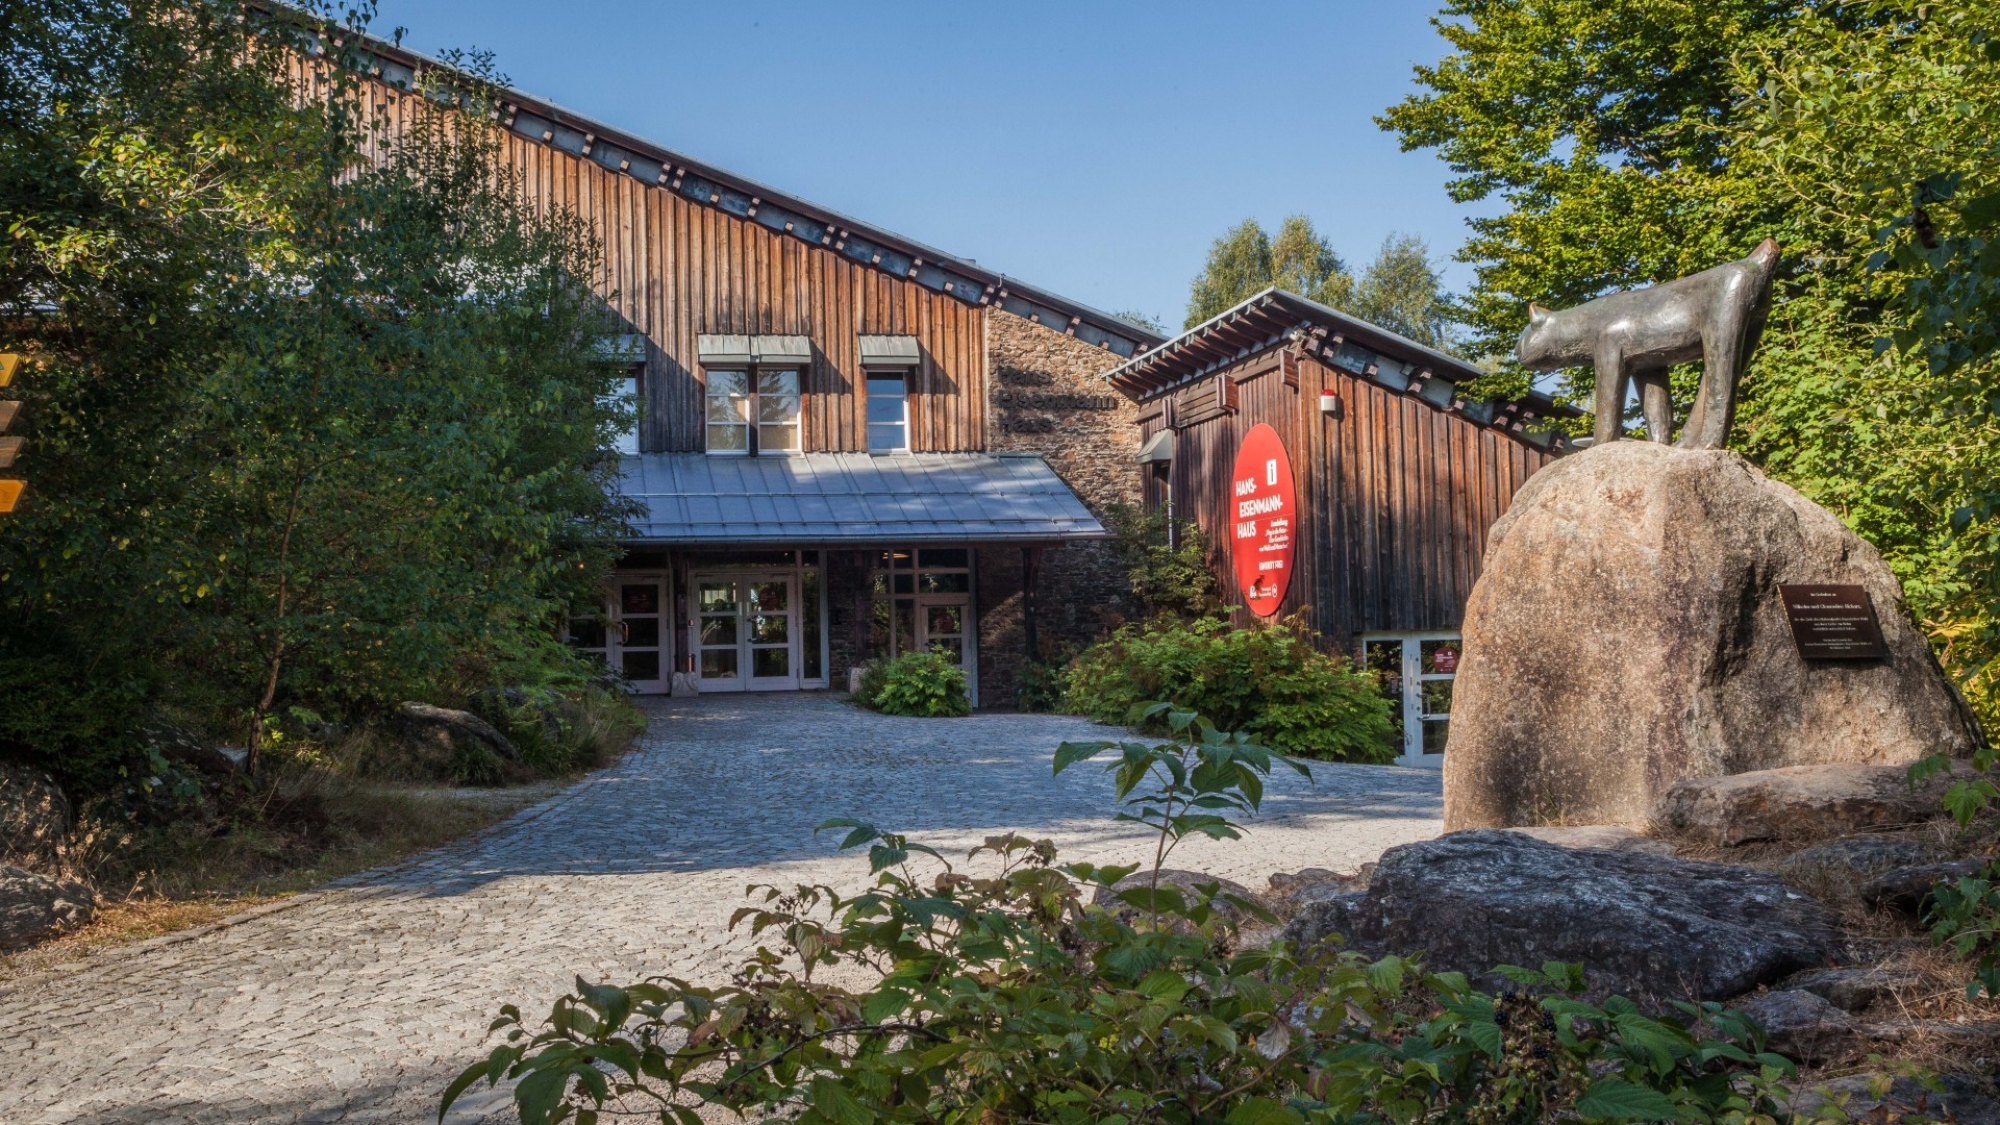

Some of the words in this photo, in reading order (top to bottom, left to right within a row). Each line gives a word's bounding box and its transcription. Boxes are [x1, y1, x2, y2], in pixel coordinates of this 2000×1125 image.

[998, 366, 1052, 385] Hans
[1236, 477, 1257, 497] HANS-
[1239, 494, 1283, 518] EISENMANN-
[1237, 521, 1256, 539] HAUS
